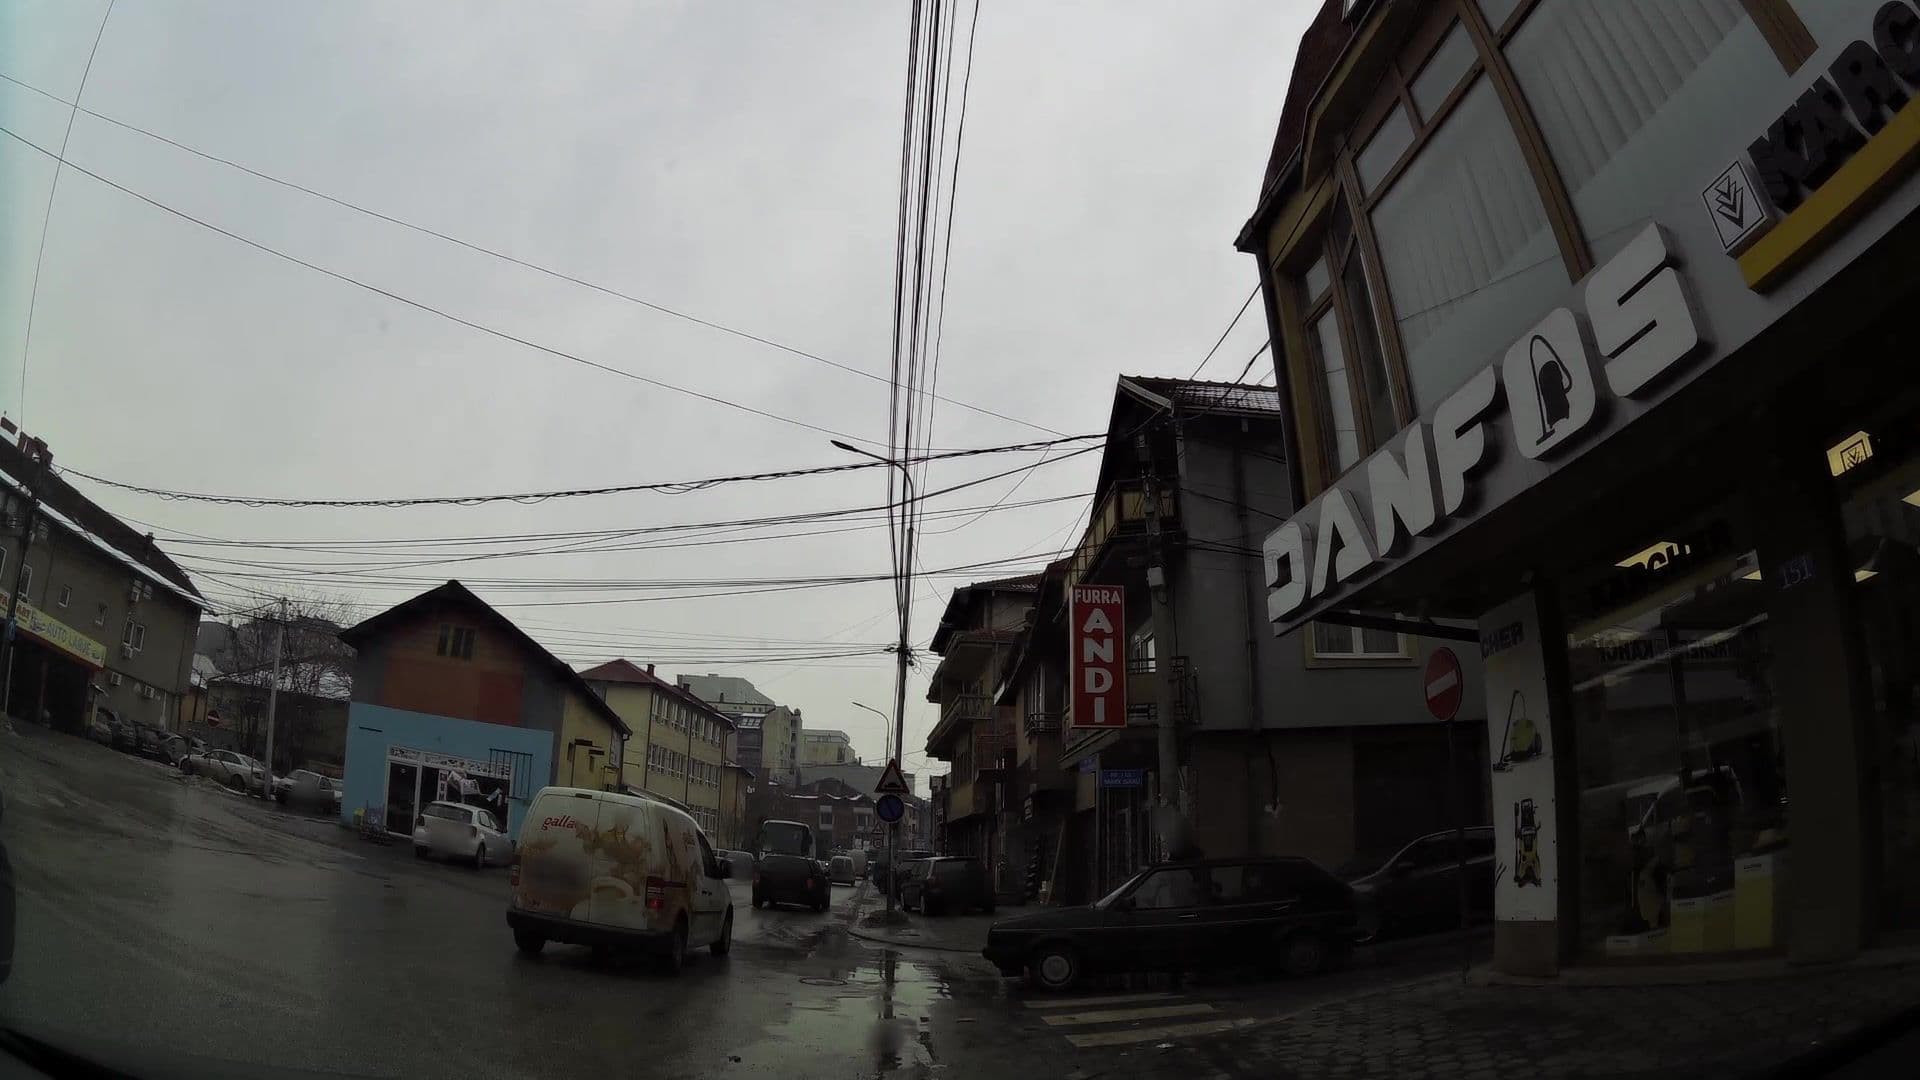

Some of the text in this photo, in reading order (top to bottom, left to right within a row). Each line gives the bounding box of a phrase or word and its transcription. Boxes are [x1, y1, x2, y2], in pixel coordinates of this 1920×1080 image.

[1747, 0, 1920, 212] KÄRC
[1263, 221, 1699, 624] DANFOS
[1074, 589, 1122, 605] FURRA
[1082, 607, 1114, 724] ANDI
